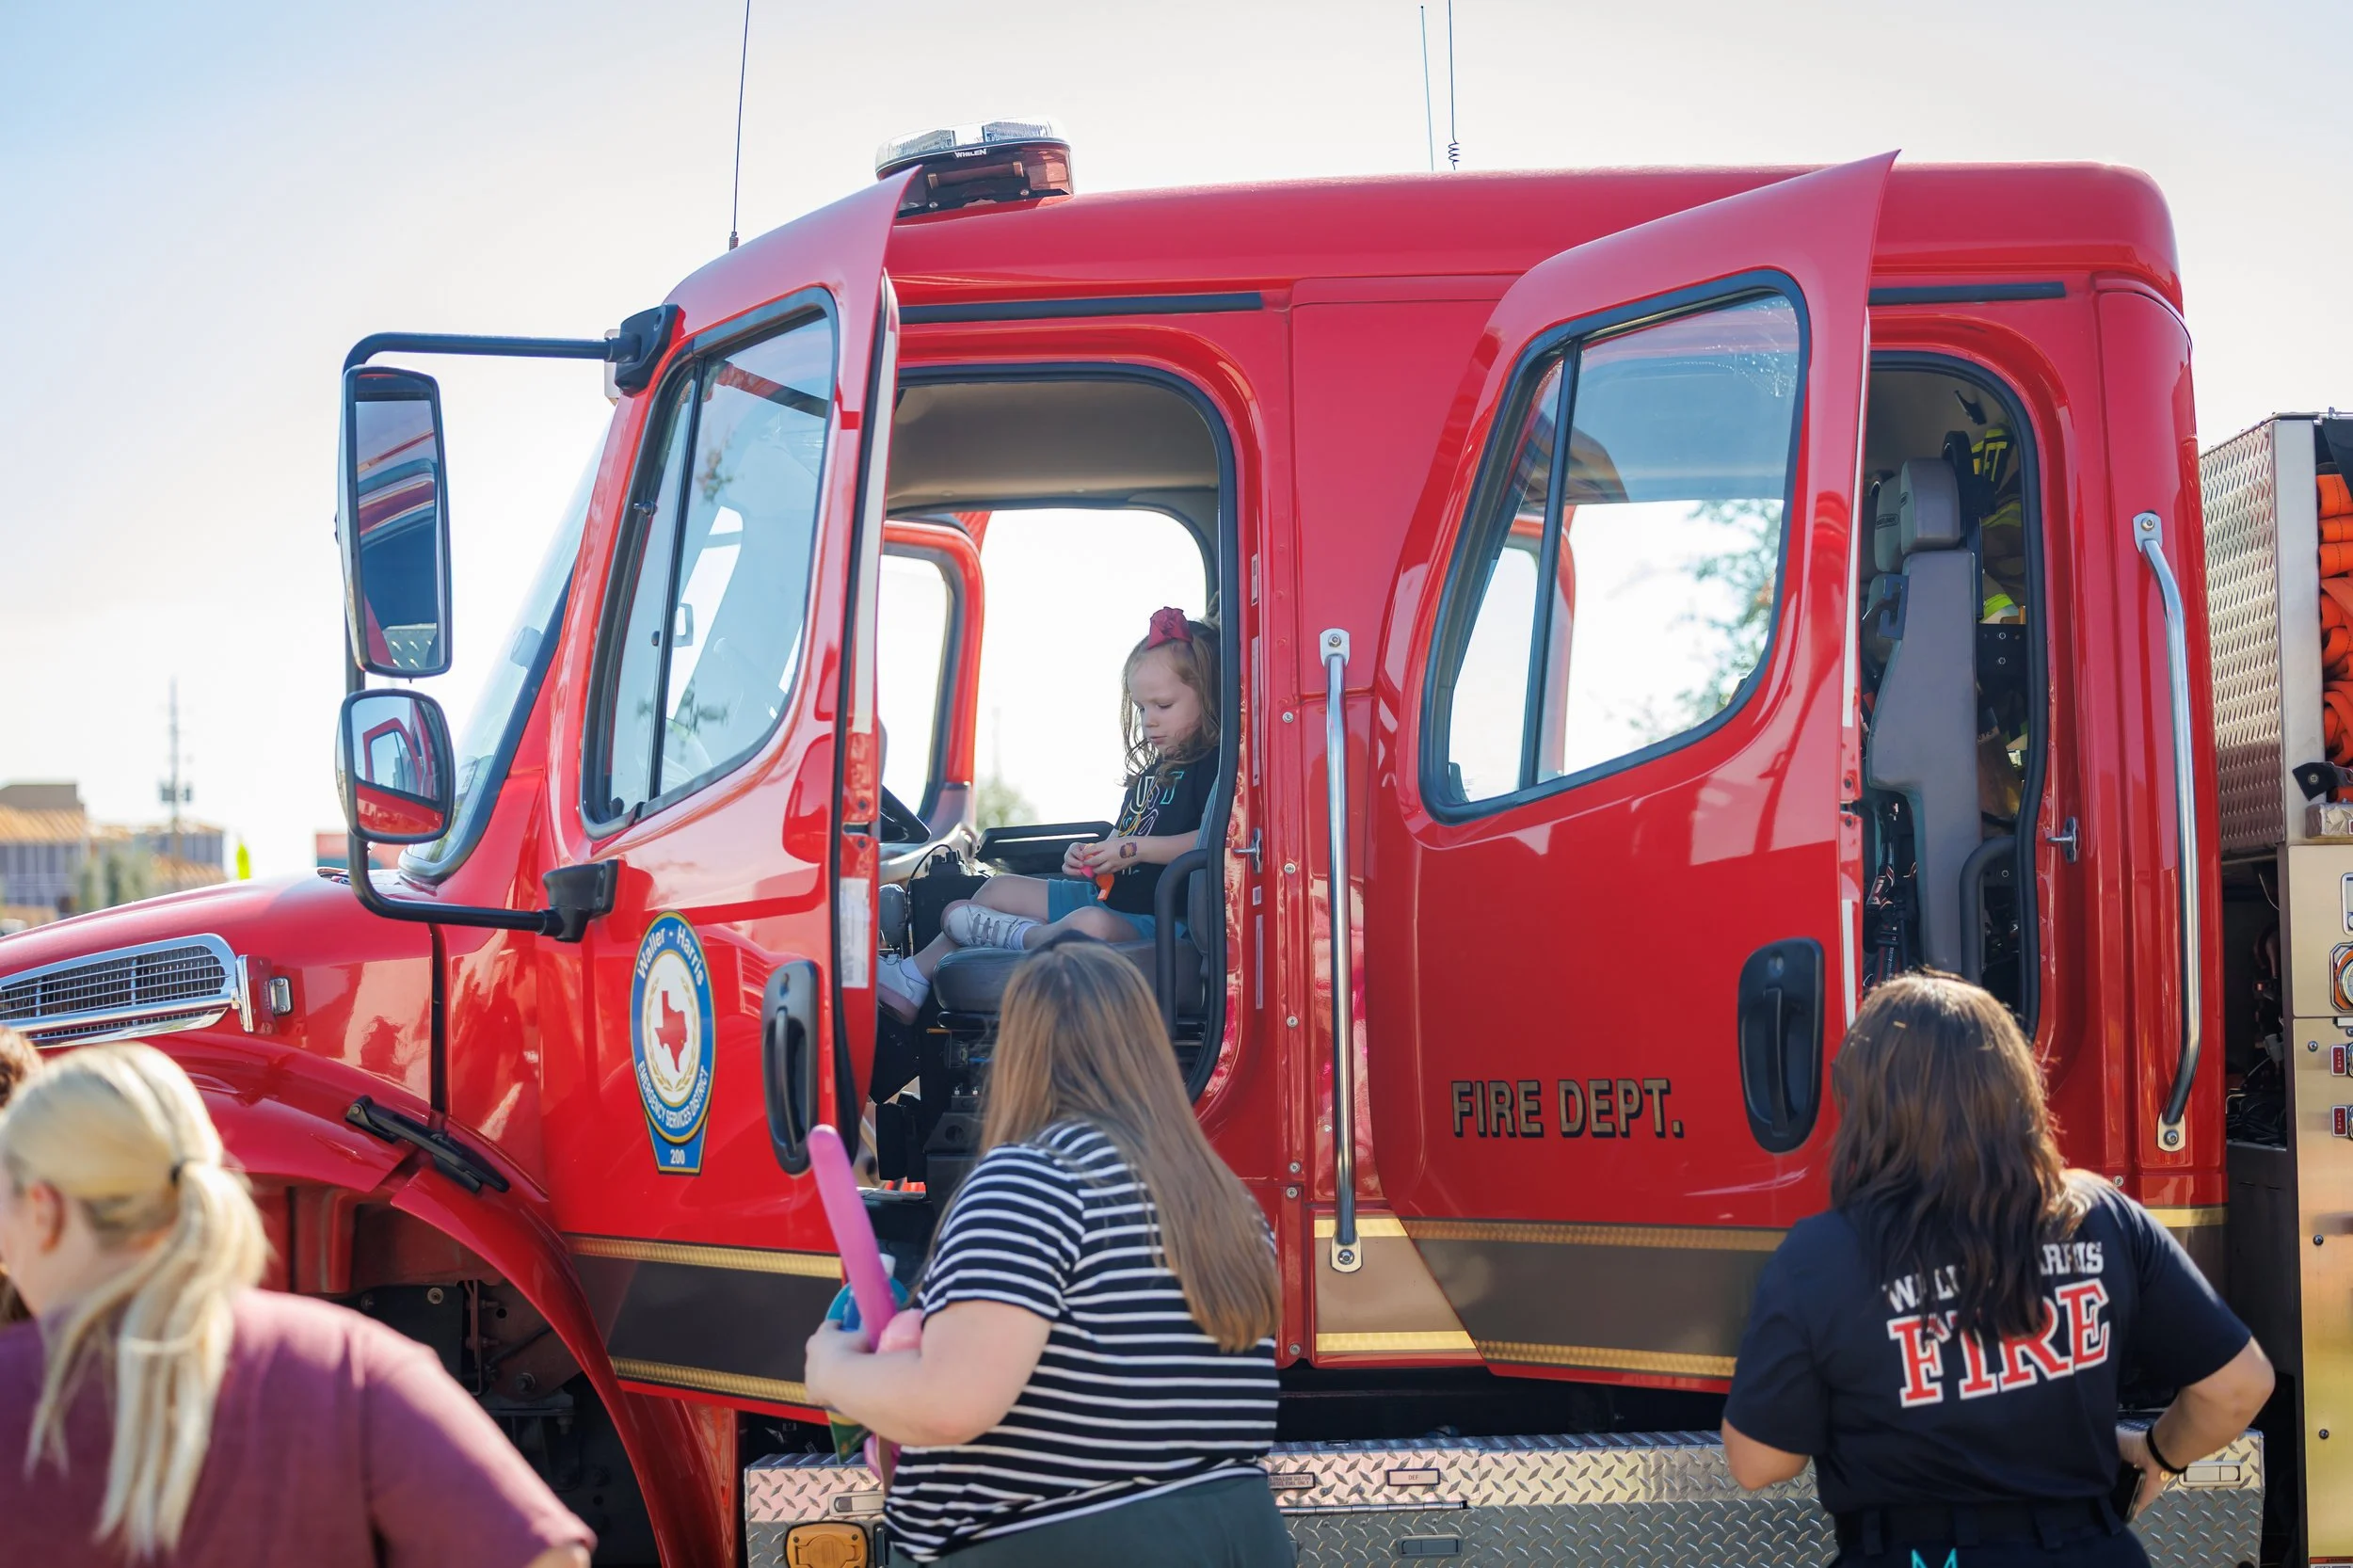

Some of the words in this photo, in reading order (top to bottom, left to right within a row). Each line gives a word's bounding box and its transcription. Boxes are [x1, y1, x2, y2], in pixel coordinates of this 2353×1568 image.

[637, 927, 665, 980] Waller
[677, 924, 704, 986] Harris
[637, 1060, 667, 1123] EMERGENCY
[665, 1105, 693, 1129] SERVICES
[689, 1064, 709, 1117] DISTRICT
[1450, 1080, 1545, 1138] FIRE
[1558, 1079, 1685, 1139] DEPT.
[669, 1148, 686, 1165] 200
[1887, 1278, 2110, 1408] FIRE
